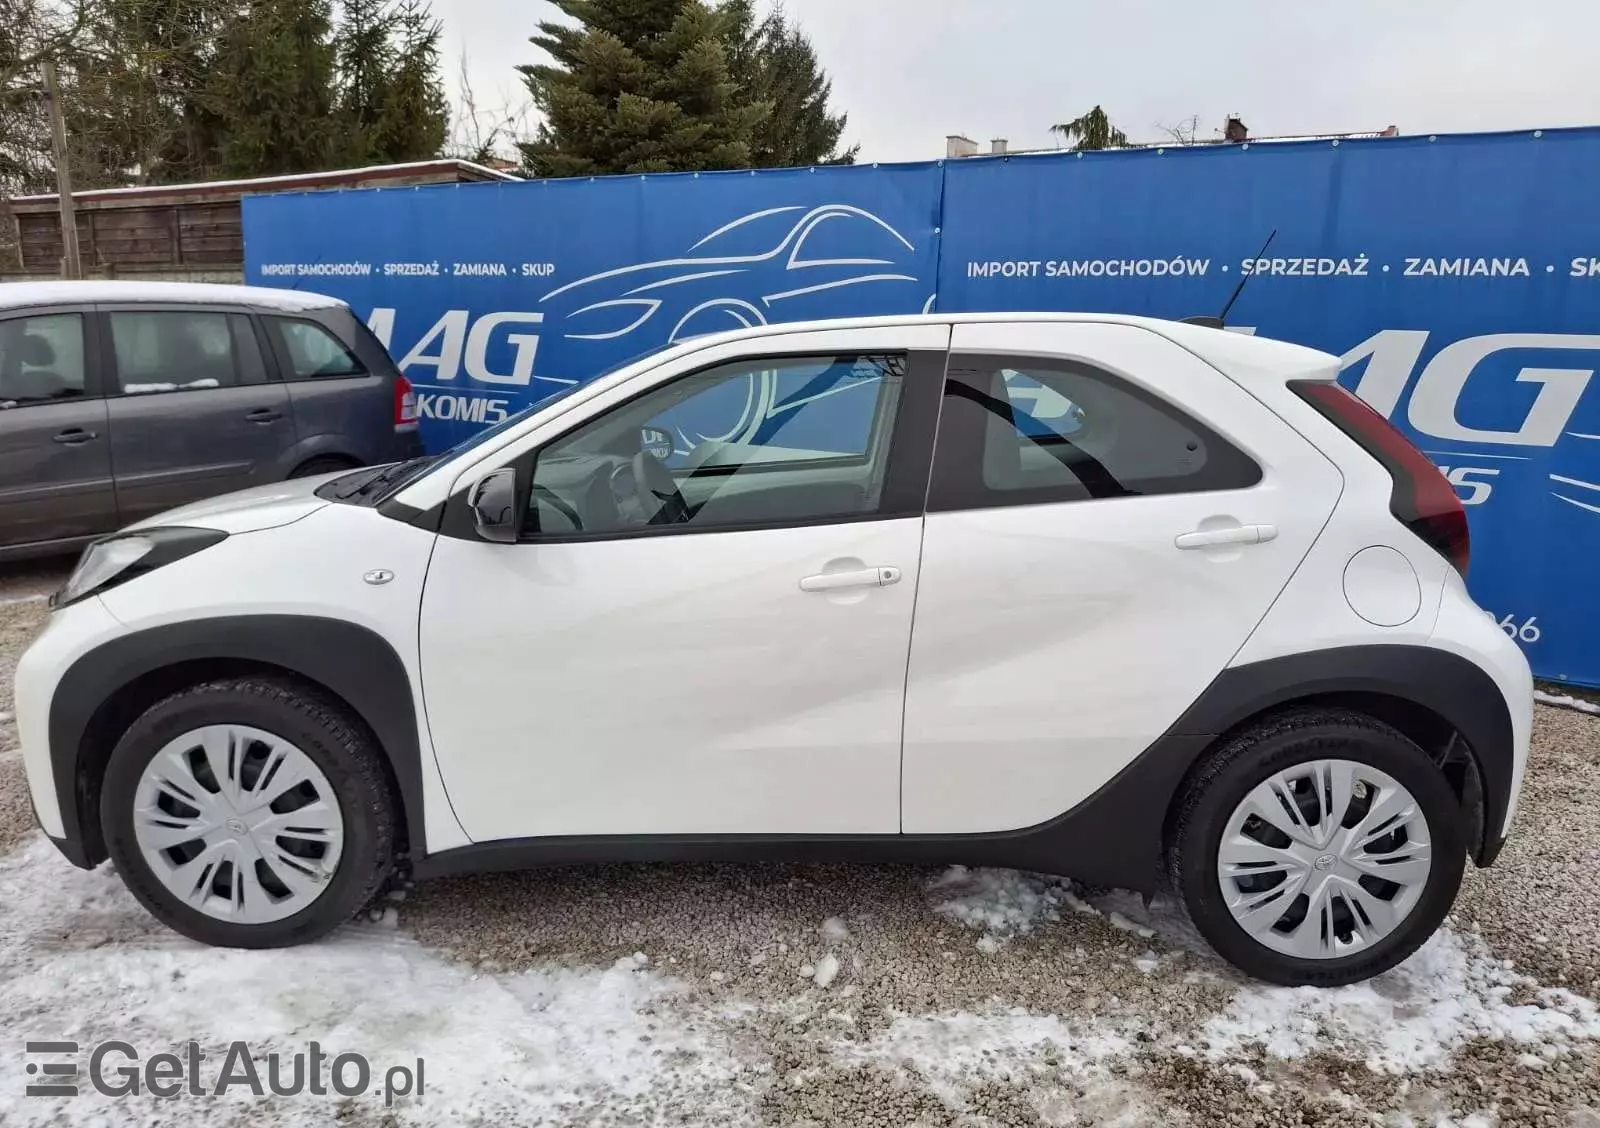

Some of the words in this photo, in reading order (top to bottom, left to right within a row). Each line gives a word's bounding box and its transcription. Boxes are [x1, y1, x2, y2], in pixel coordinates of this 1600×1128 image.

[261, 263, 296, 277] IMPORT
[298, 260, 372, 277] SAMOCHODÓW
[383, 260, 440, 276] SPRZEDAŻ
[453, 263, 507, 276] ZAMIANA
[522, 263, 555, 277] SKUP
[967, 261, 1041, 277] IMPORT
[1045, 255, 1210, 277] SAMOCHODÓW
[1241, 252, 1370, 277] SPRZEDAŻ
[1403, 257, 1531, 277] ZAMIANA
[1337, 329, 1600, 447] AG
[416, 393, 510, 425] KOMIS
[1484, 610, 1541, 643] 66
